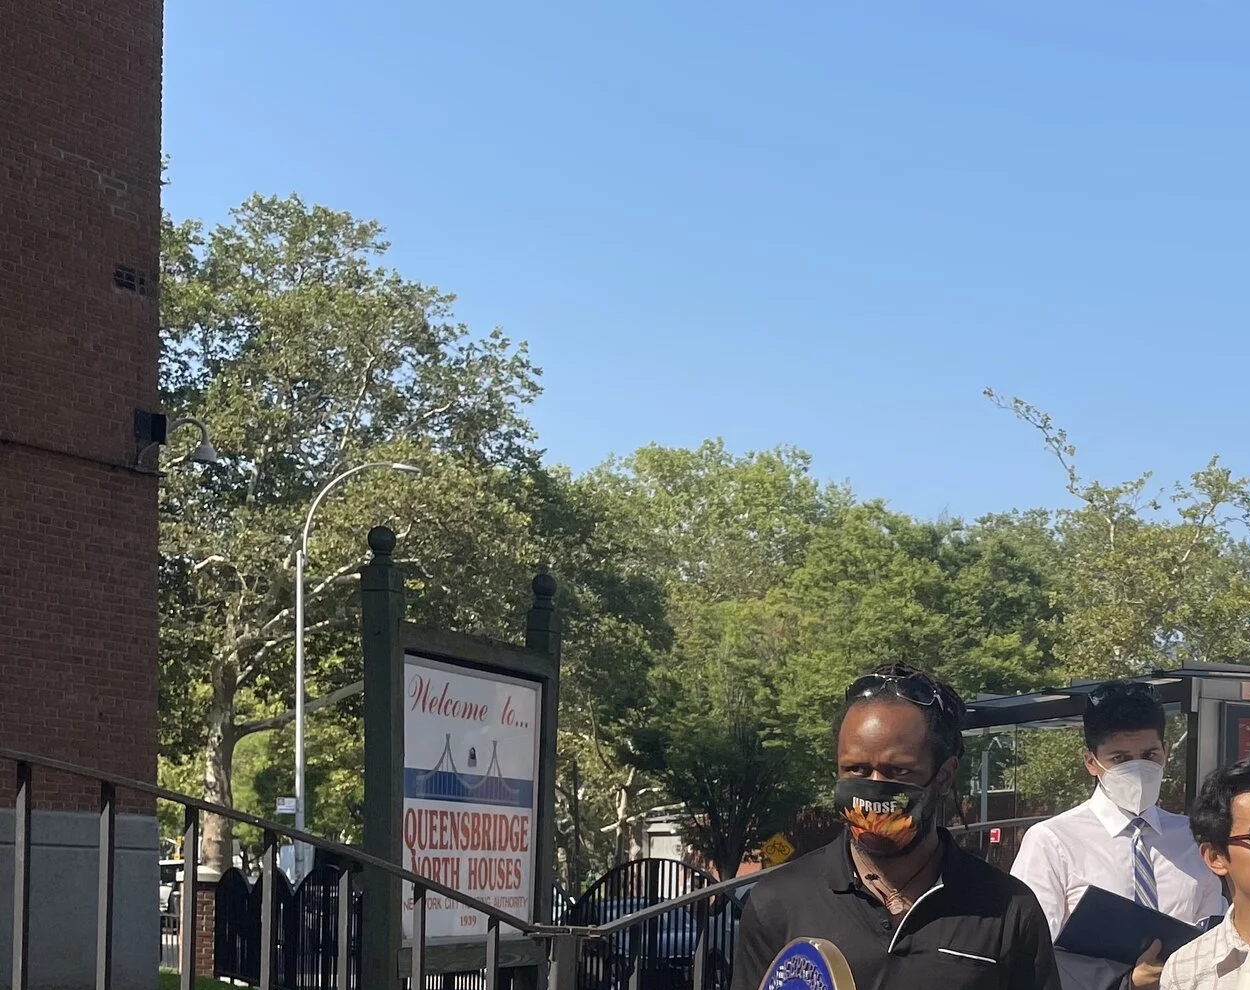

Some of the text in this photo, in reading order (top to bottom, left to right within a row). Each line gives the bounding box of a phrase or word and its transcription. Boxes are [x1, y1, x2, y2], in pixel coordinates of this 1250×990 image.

[408, 674, 488, 721] Welcome
[404, 808, 529, 854] QUEENSBRIDGE
[411, 856, 522, 890] NORTH HOUSES
[460, 915, 477, 927] 1939
